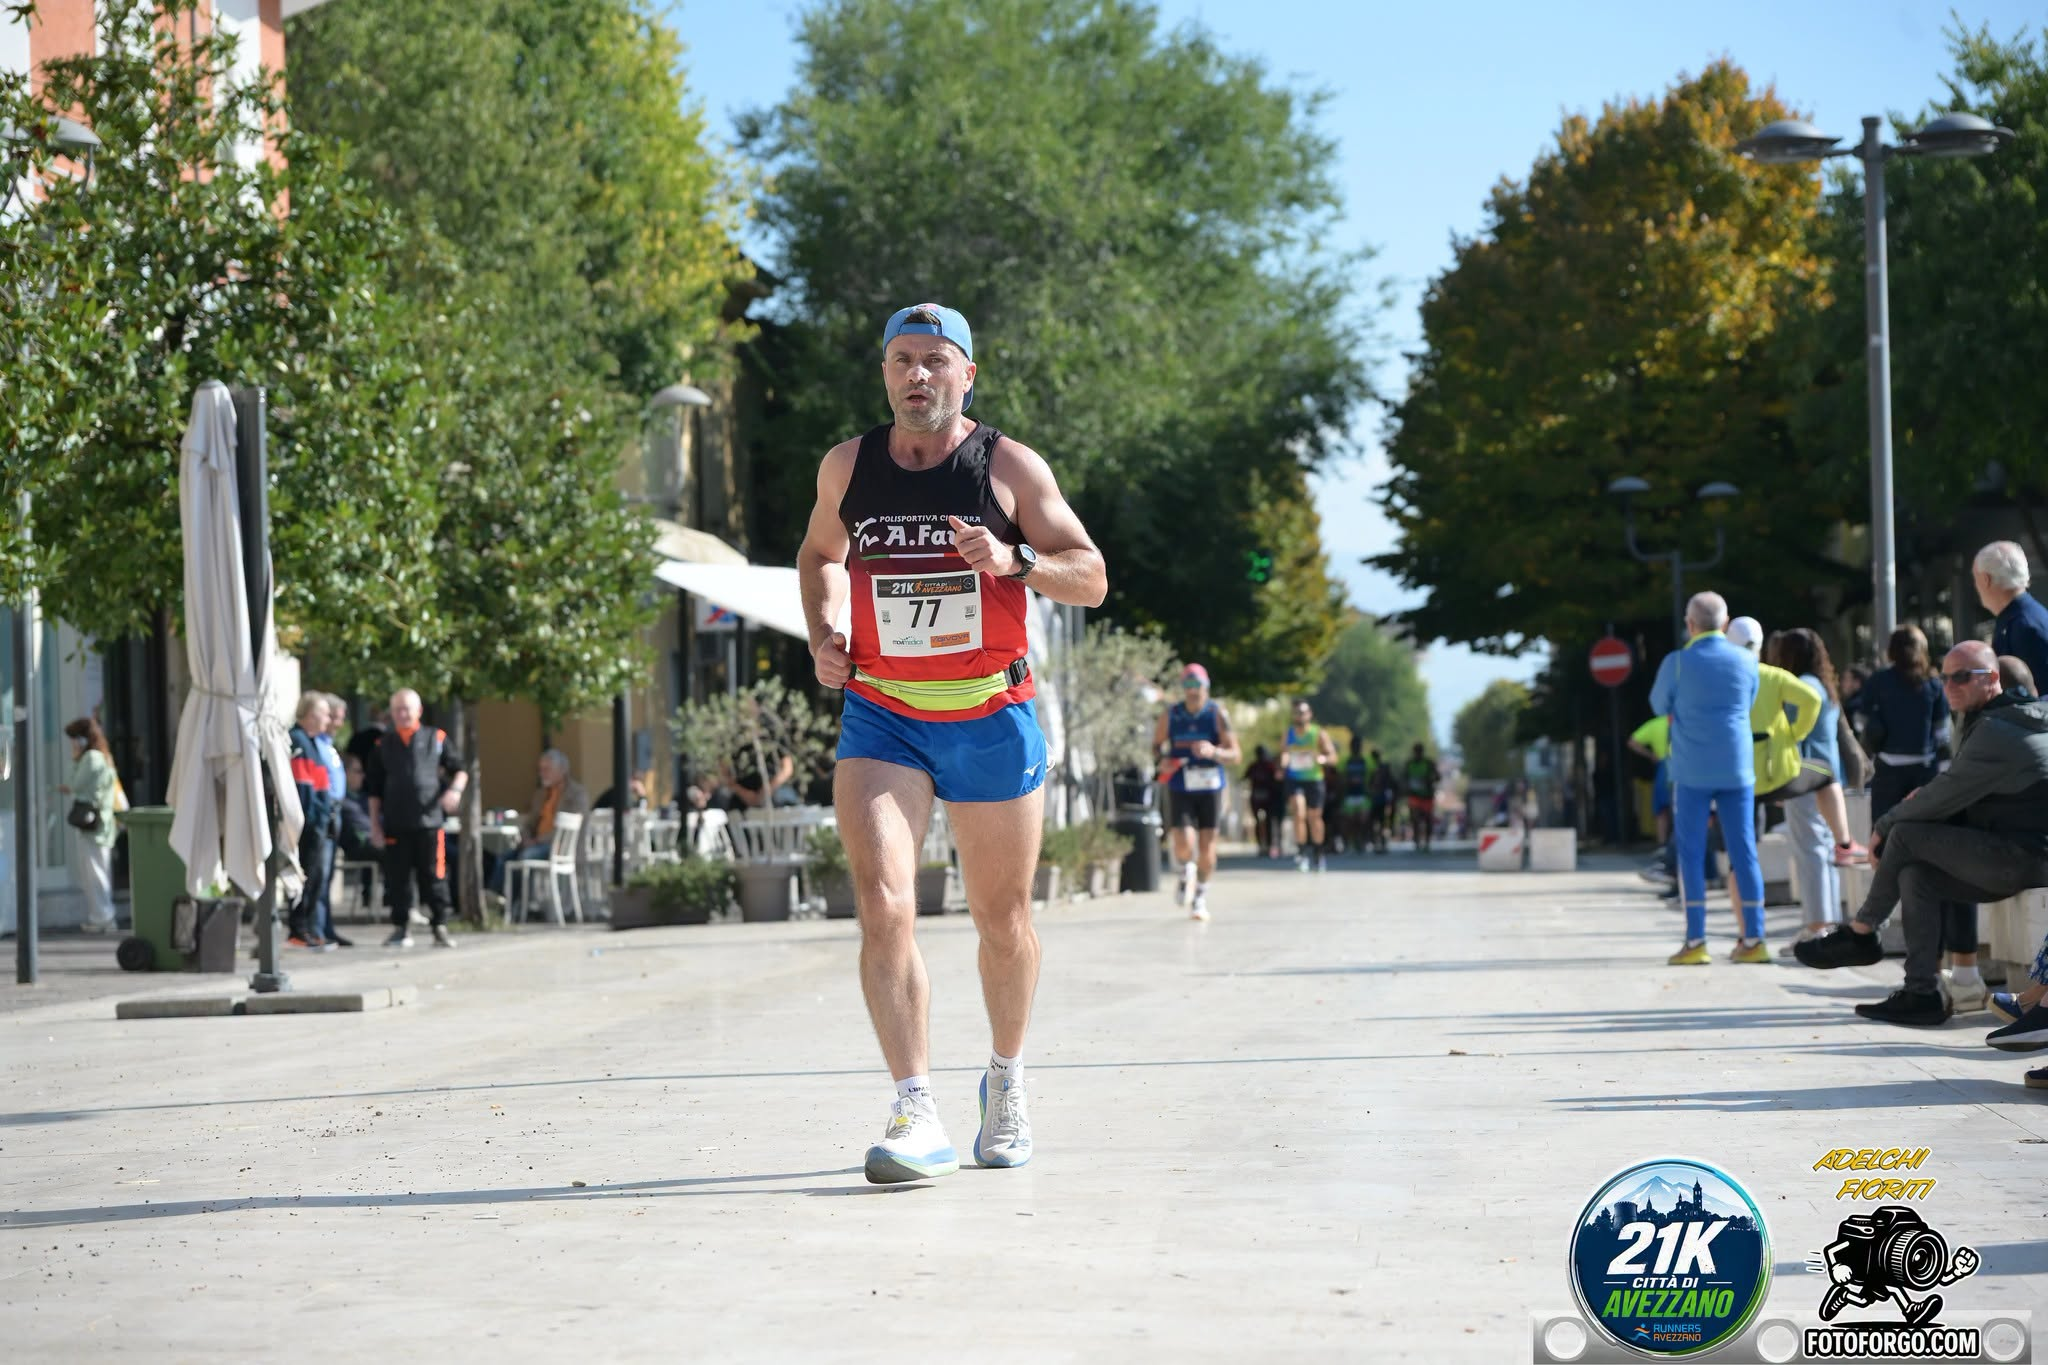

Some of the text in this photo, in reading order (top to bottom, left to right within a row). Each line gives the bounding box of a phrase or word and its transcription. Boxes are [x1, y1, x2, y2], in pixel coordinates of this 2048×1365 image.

[879, 514, 981, 523] POLISPORTIVA CICIARA
[891, 582, 915, 595] 21K
[909, 598, 942, 629] 77
